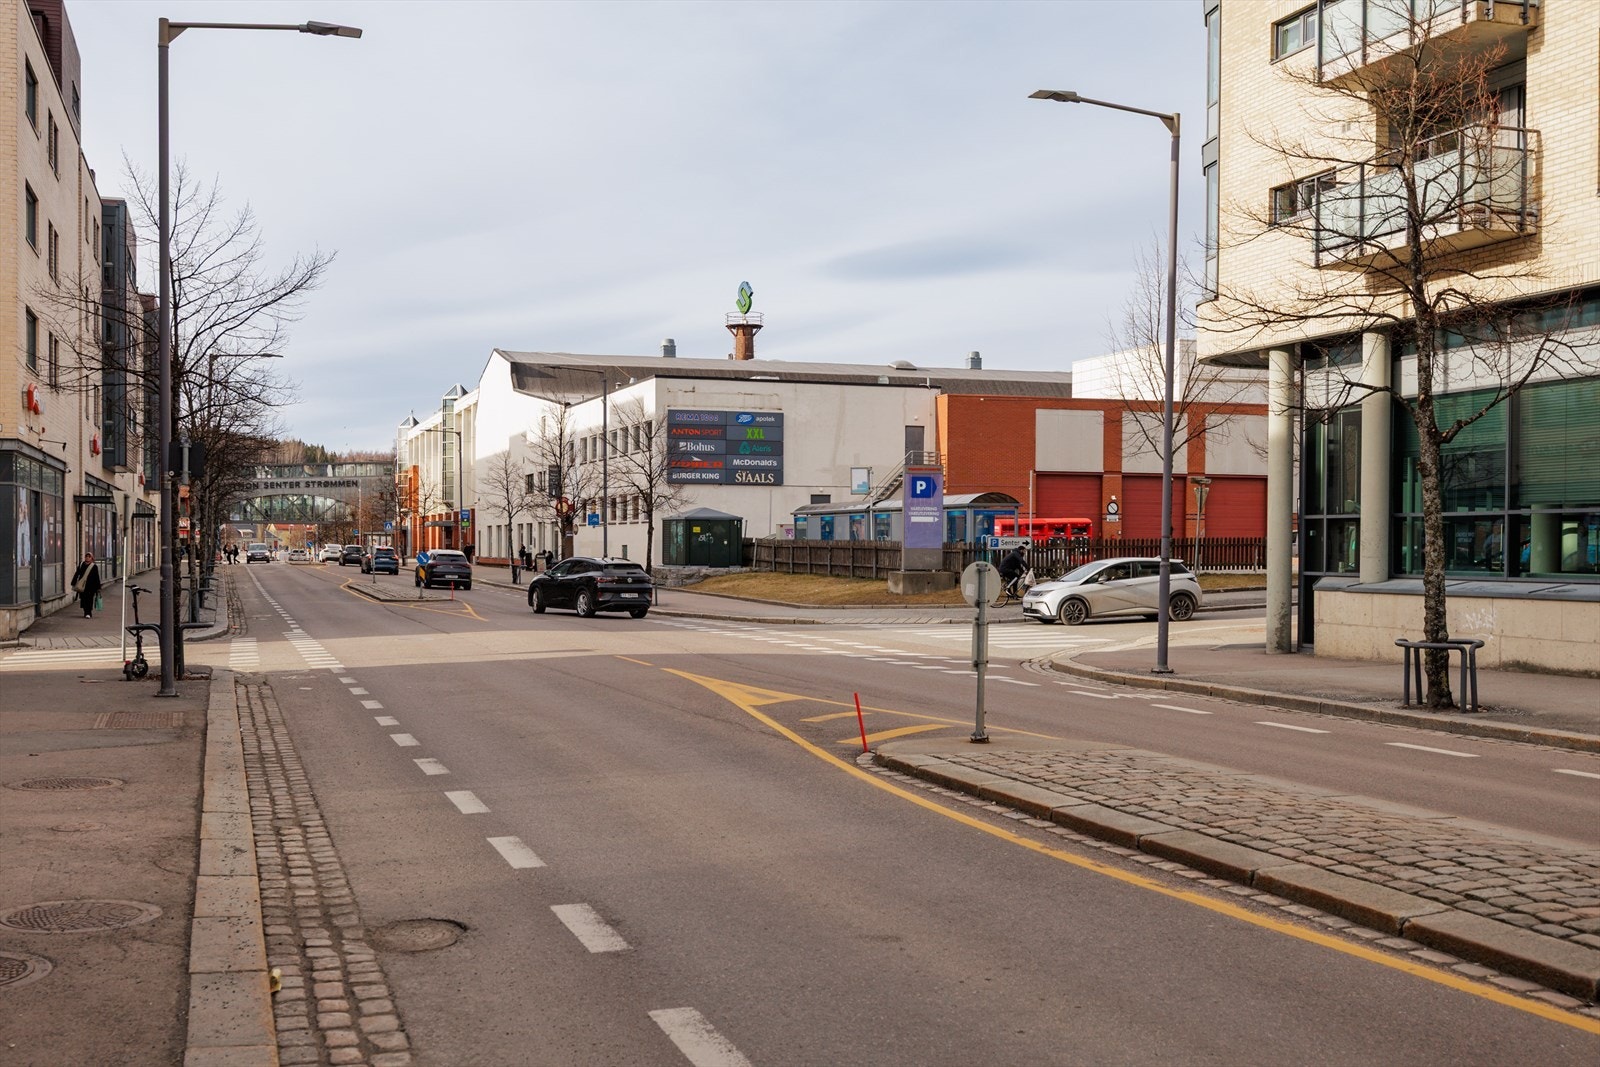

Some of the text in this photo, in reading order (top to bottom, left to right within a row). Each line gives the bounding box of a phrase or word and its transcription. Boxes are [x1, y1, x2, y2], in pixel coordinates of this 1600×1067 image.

[746, 428, 764, 439] XXL
[687, 442, 715, 451] Bohus
[732, 458, 778, 466] McDonald's
[916, 480, 926, 494] P
